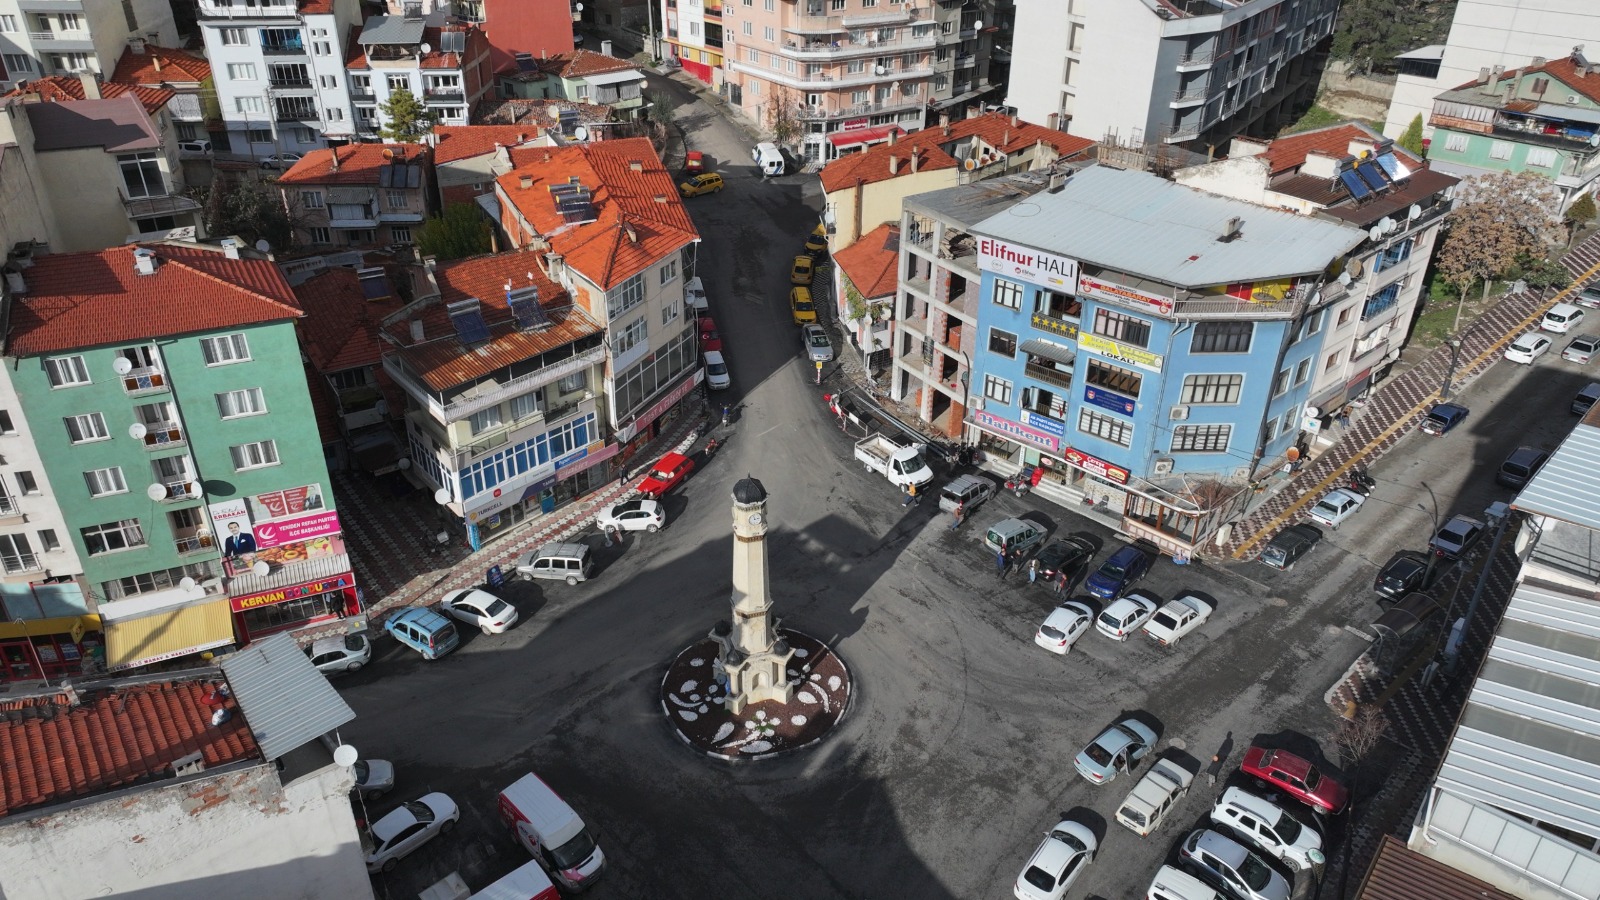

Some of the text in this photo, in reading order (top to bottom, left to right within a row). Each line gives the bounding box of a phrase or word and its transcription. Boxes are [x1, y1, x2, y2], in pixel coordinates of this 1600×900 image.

[981, 239, 1074, 278] Elifnur HALI
[1100, 285, 1152, 303] GALATASARAY
[213, 510, 246, 520] ERBAKAN
[240, 591, 285, 608] KERVAN
